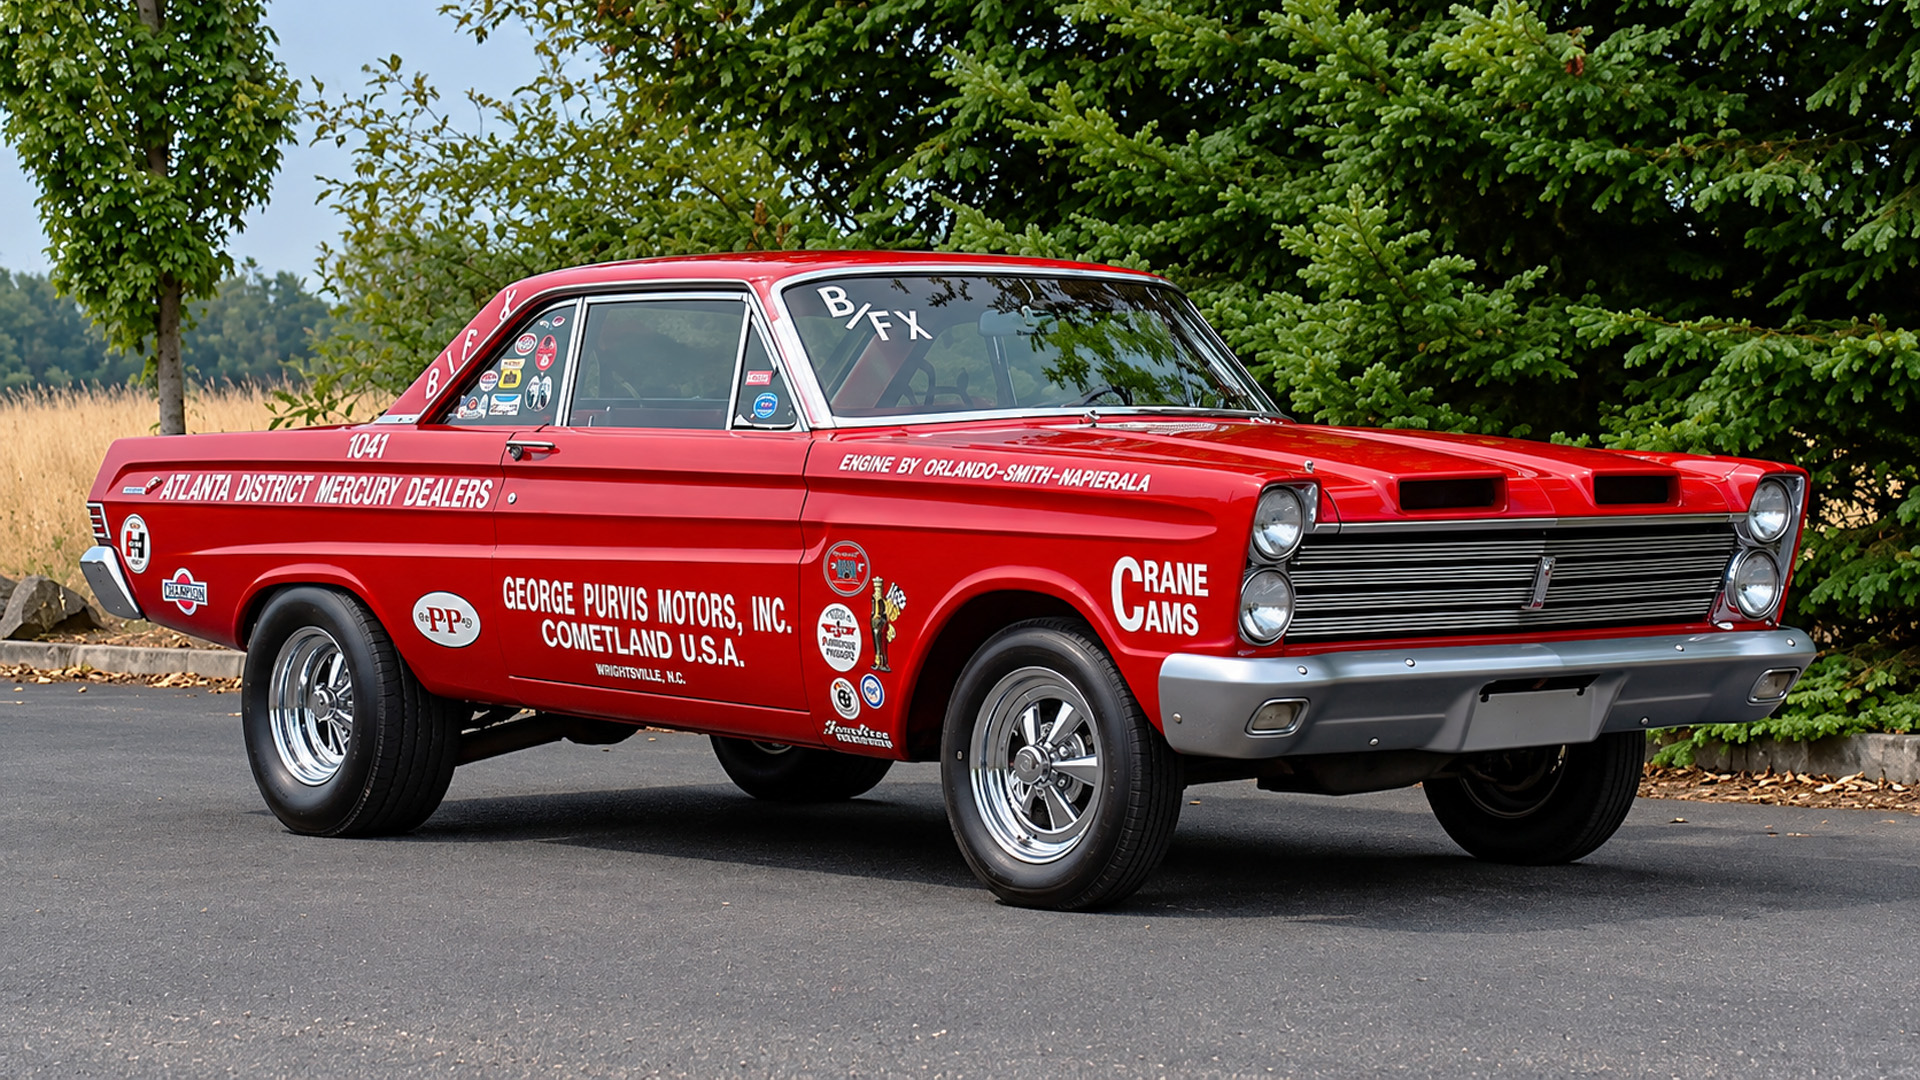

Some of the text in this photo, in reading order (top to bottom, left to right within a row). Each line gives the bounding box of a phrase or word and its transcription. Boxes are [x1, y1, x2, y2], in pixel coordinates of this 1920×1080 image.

[347, 433, 390, 459] 1041
[839, 454, 1151, 492] ENGINE BY ORLANDO-SMITH-NAPIERALA
[159, 474, 493, 509] ATLANTA DISTRICT MERCURY DEALERS
[503, 576, 792, 636] GEORGE PURVIS MOTORS, INC.
[541, 619, 745, 667] COMETLAND U.S.A.
[595, 663, 686, 684] WRIGHTSVILLE, N.C.
